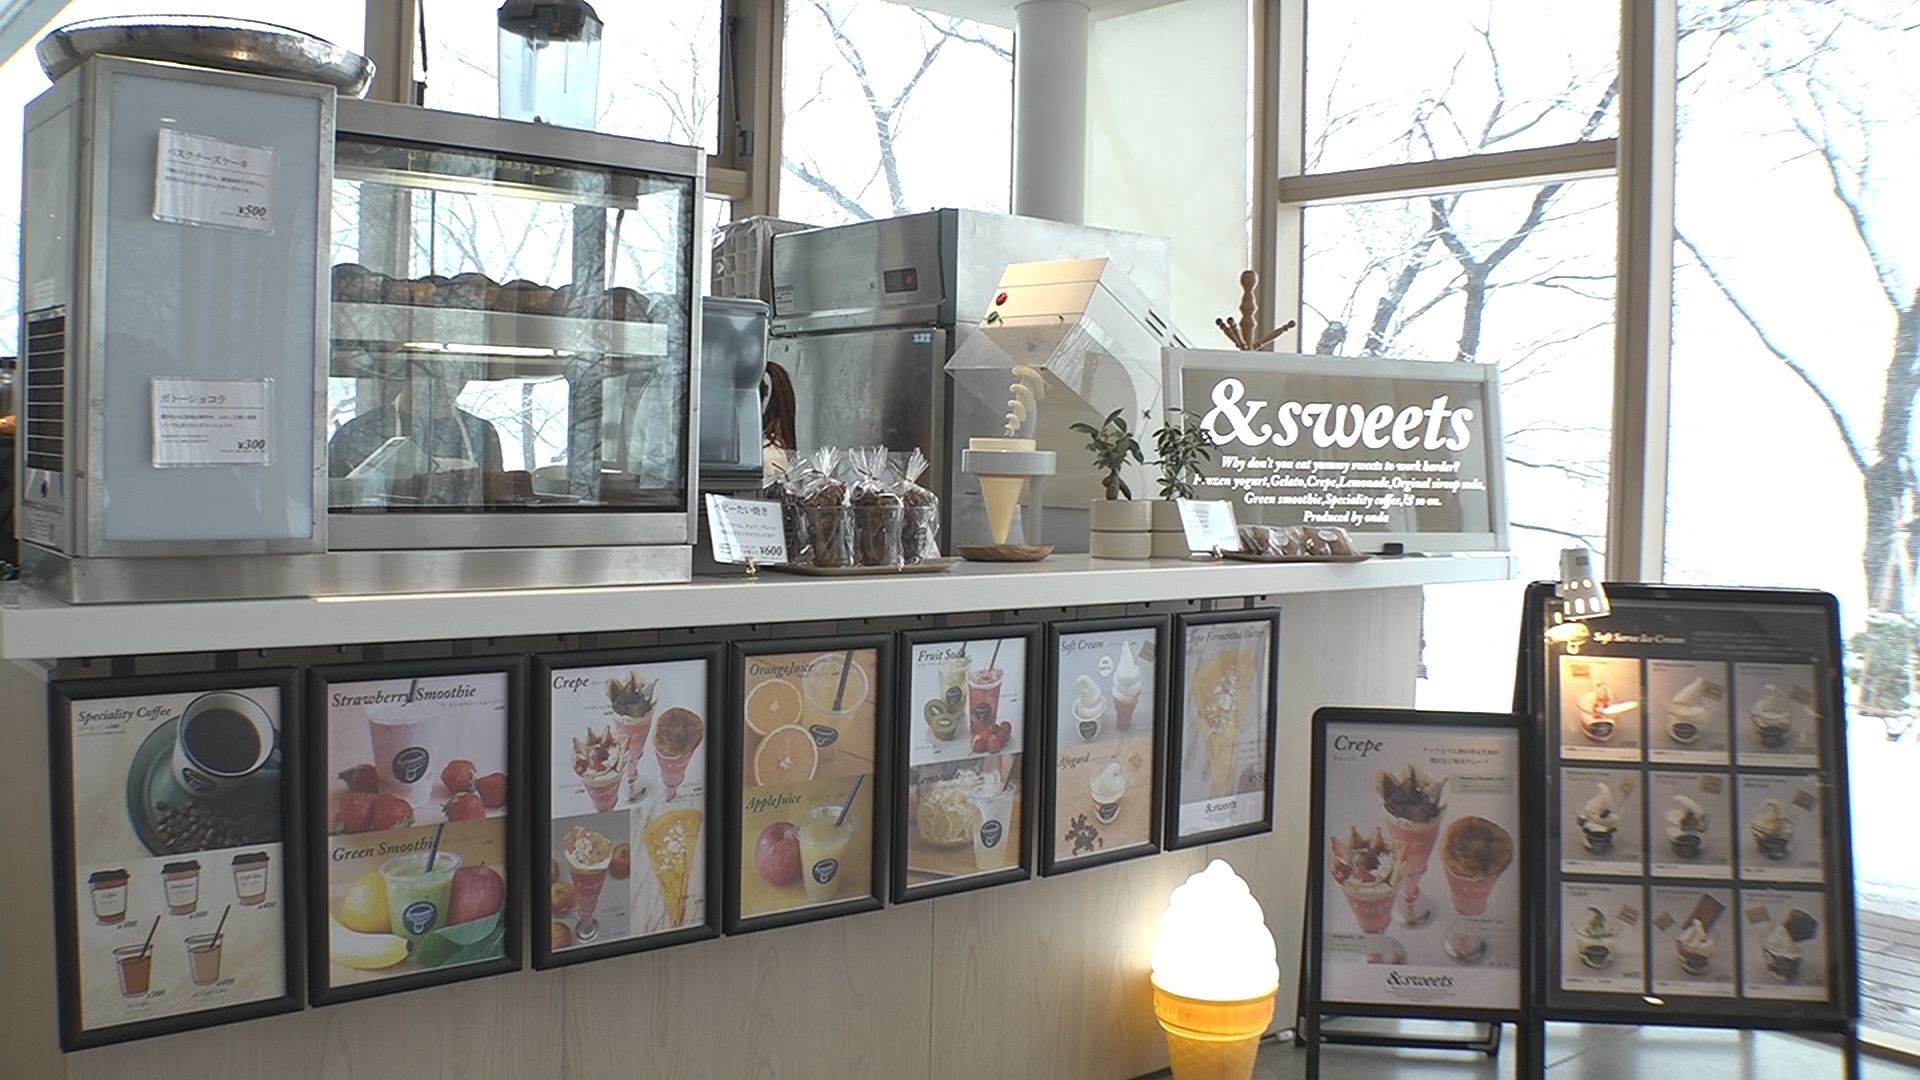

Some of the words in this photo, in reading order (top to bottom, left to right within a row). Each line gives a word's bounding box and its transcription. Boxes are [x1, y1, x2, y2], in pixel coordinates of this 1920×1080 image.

[1200, 378, 1474, 451] &sweets
[1221, 456, 1246, 472] Why
[1247, 455, 1274, 469] don't
[1273, 460, 1294, 473] you
[1312, 461, 1351, 474] yummy
[1351, 461, 1383, 471] sweets
[1384, 461, 1395, 471] to
[1396, 460, 1422, 471] work
[1422, 460, 1460, 472] harder?
[1243, 492, 1276, 504] Green
[1302, 510, 1350, 523] Produced
[1350, 511, 1363, 527] by
[759, 545, 784, 557] ¥600
[917, 649, 943, 662] Fruit
[552, 675, 590, 693] Crepe
[331, 689, 410, 708] Strawberry
[415, 684, 476, 702] Smoothie
[78, 708, 135, 726] Speciality
[135, 704, 172, 721] Coffee
[1333, 734, 1384, 758] Crepe
[332, 846, 374, 863] Green
[378, 836, 436, 857] Smoothi
